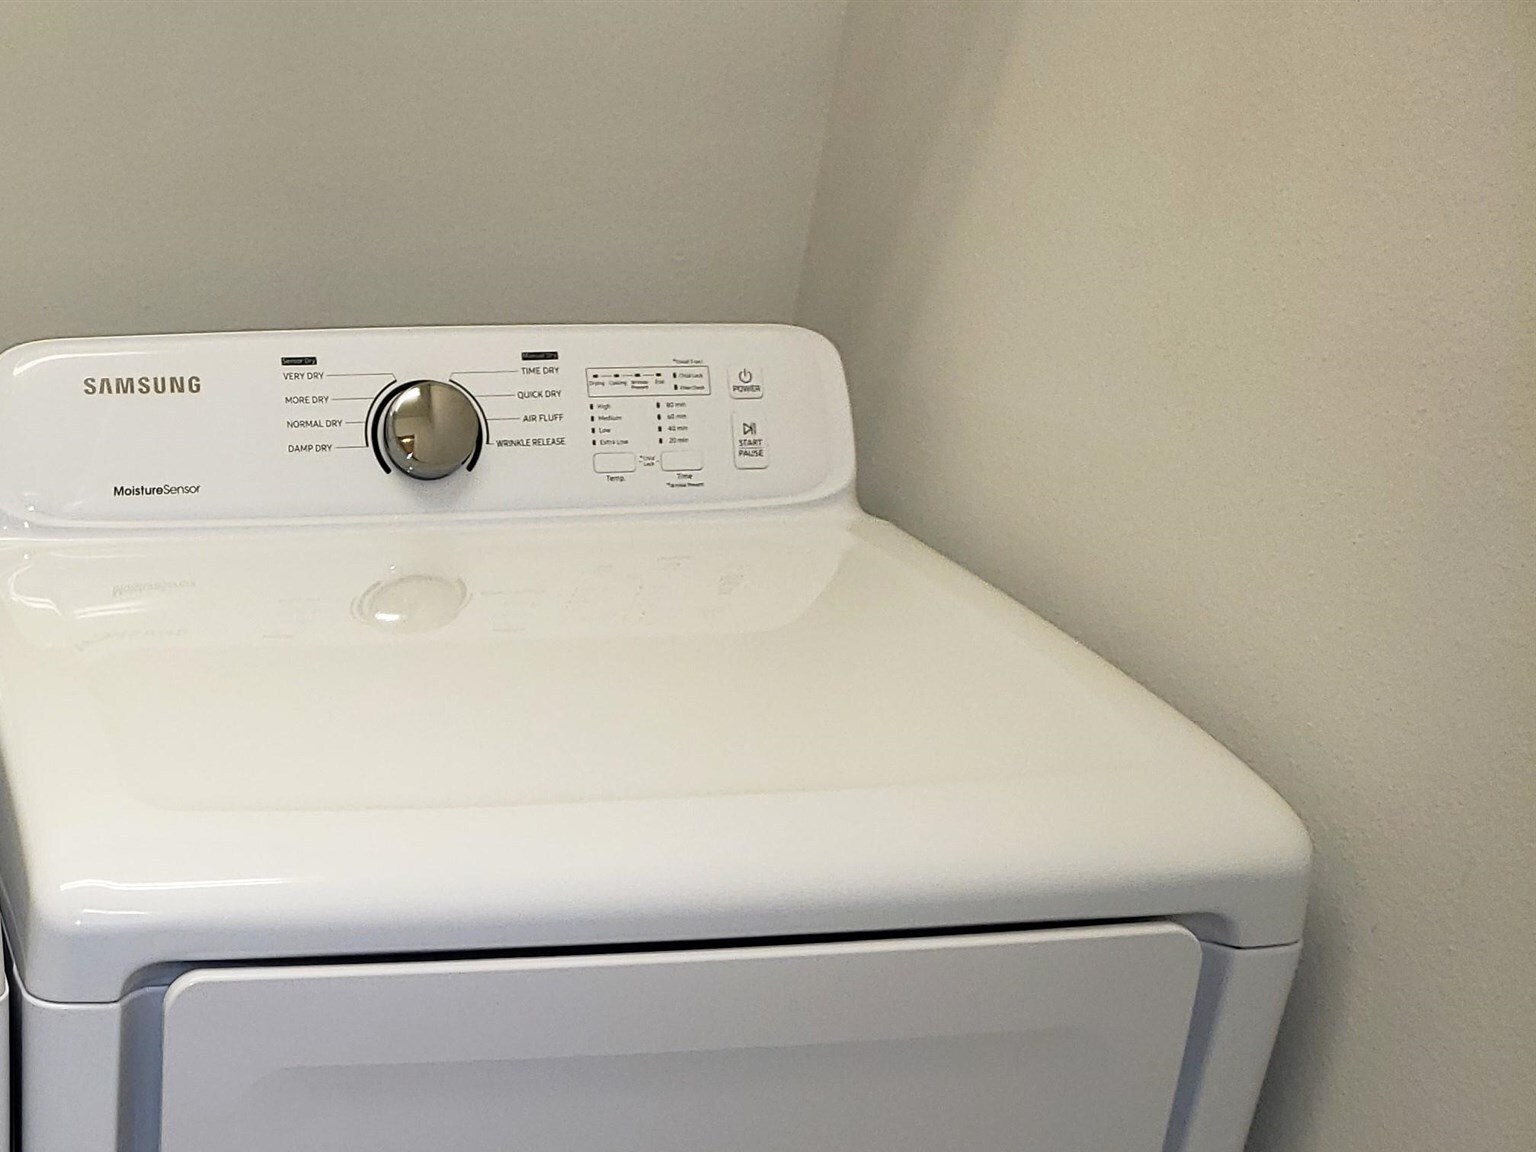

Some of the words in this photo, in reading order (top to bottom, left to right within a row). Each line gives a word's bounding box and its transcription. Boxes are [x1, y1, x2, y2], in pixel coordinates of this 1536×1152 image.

[282, 371, 304, 381] VERY
[306, 371, 324, 381] DRY
[520, 366, 540, 376] TIME
[543, 366, 560, 375] DRY
[82, 375, 202, 395] SAMSUNG
[284, 395, 309, 405] MORE
[310, 395, 329, 405] DRY
[516, 390, 543, 400] QUICK
[544, 390, 562, 399] DRY
[522, 414, 537, 423] AIR
[539, 413, 564, 423] FLUFF
[285, 419, 323, 429] NORMAL
[325, 418, 344, 428] DRY
[495, 438, 531, 448] WRINKLE
[532, 437, 566, 447] RELEASE
[287, 444, 313, 453] DAMP
[315, 443, 333, 453] DRY
[738, 449, 764, 457] PAUSE
[112, 483, 201, 497] MoistureSensor
